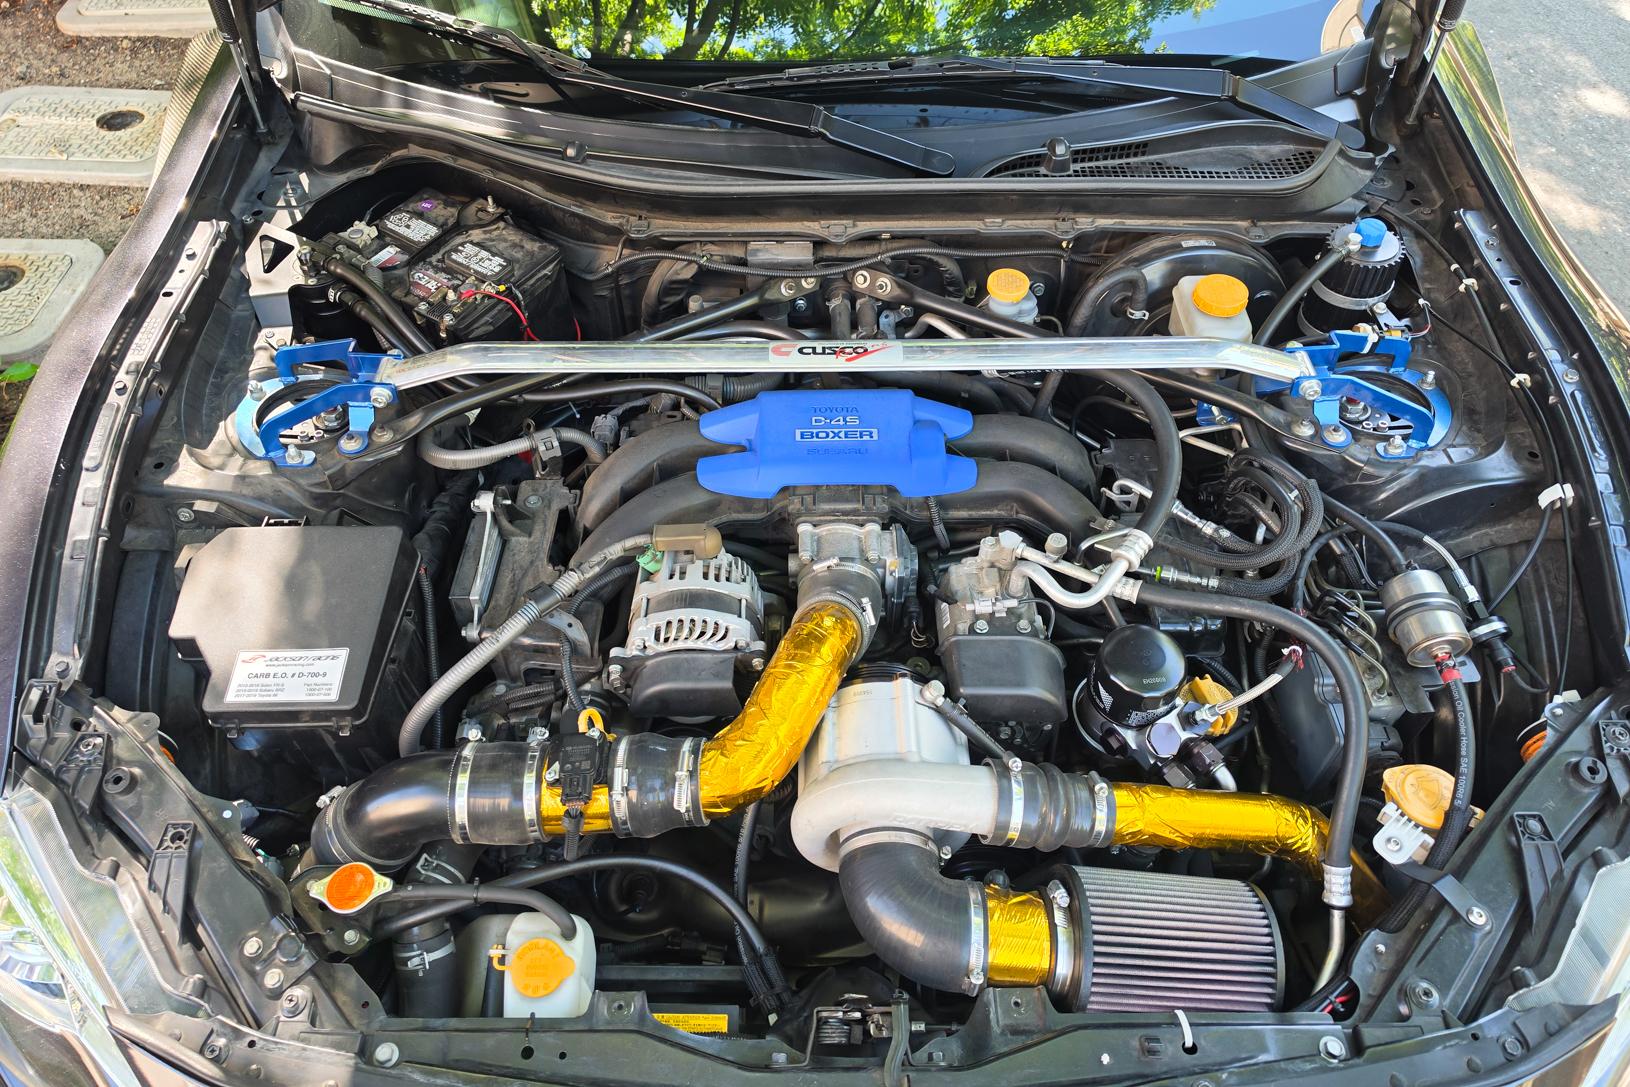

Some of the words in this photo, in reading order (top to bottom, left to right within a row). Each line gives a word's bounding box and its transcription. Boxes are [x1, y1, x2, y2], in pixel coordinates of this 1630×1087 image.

[811, 416, 860, 426] D-4S
[799, 430, 874, 440] BOXER
[297, 671, 327, 679] D-700-9
[1455, 700, 1463, 710] Oil
[1457, 711, 1466, 735] Cooler
[1460, 737, 1468, 755] Hose
[1459, 757, 1468, 773] SAE
[1455, 775, 1466, 799] 100R6
